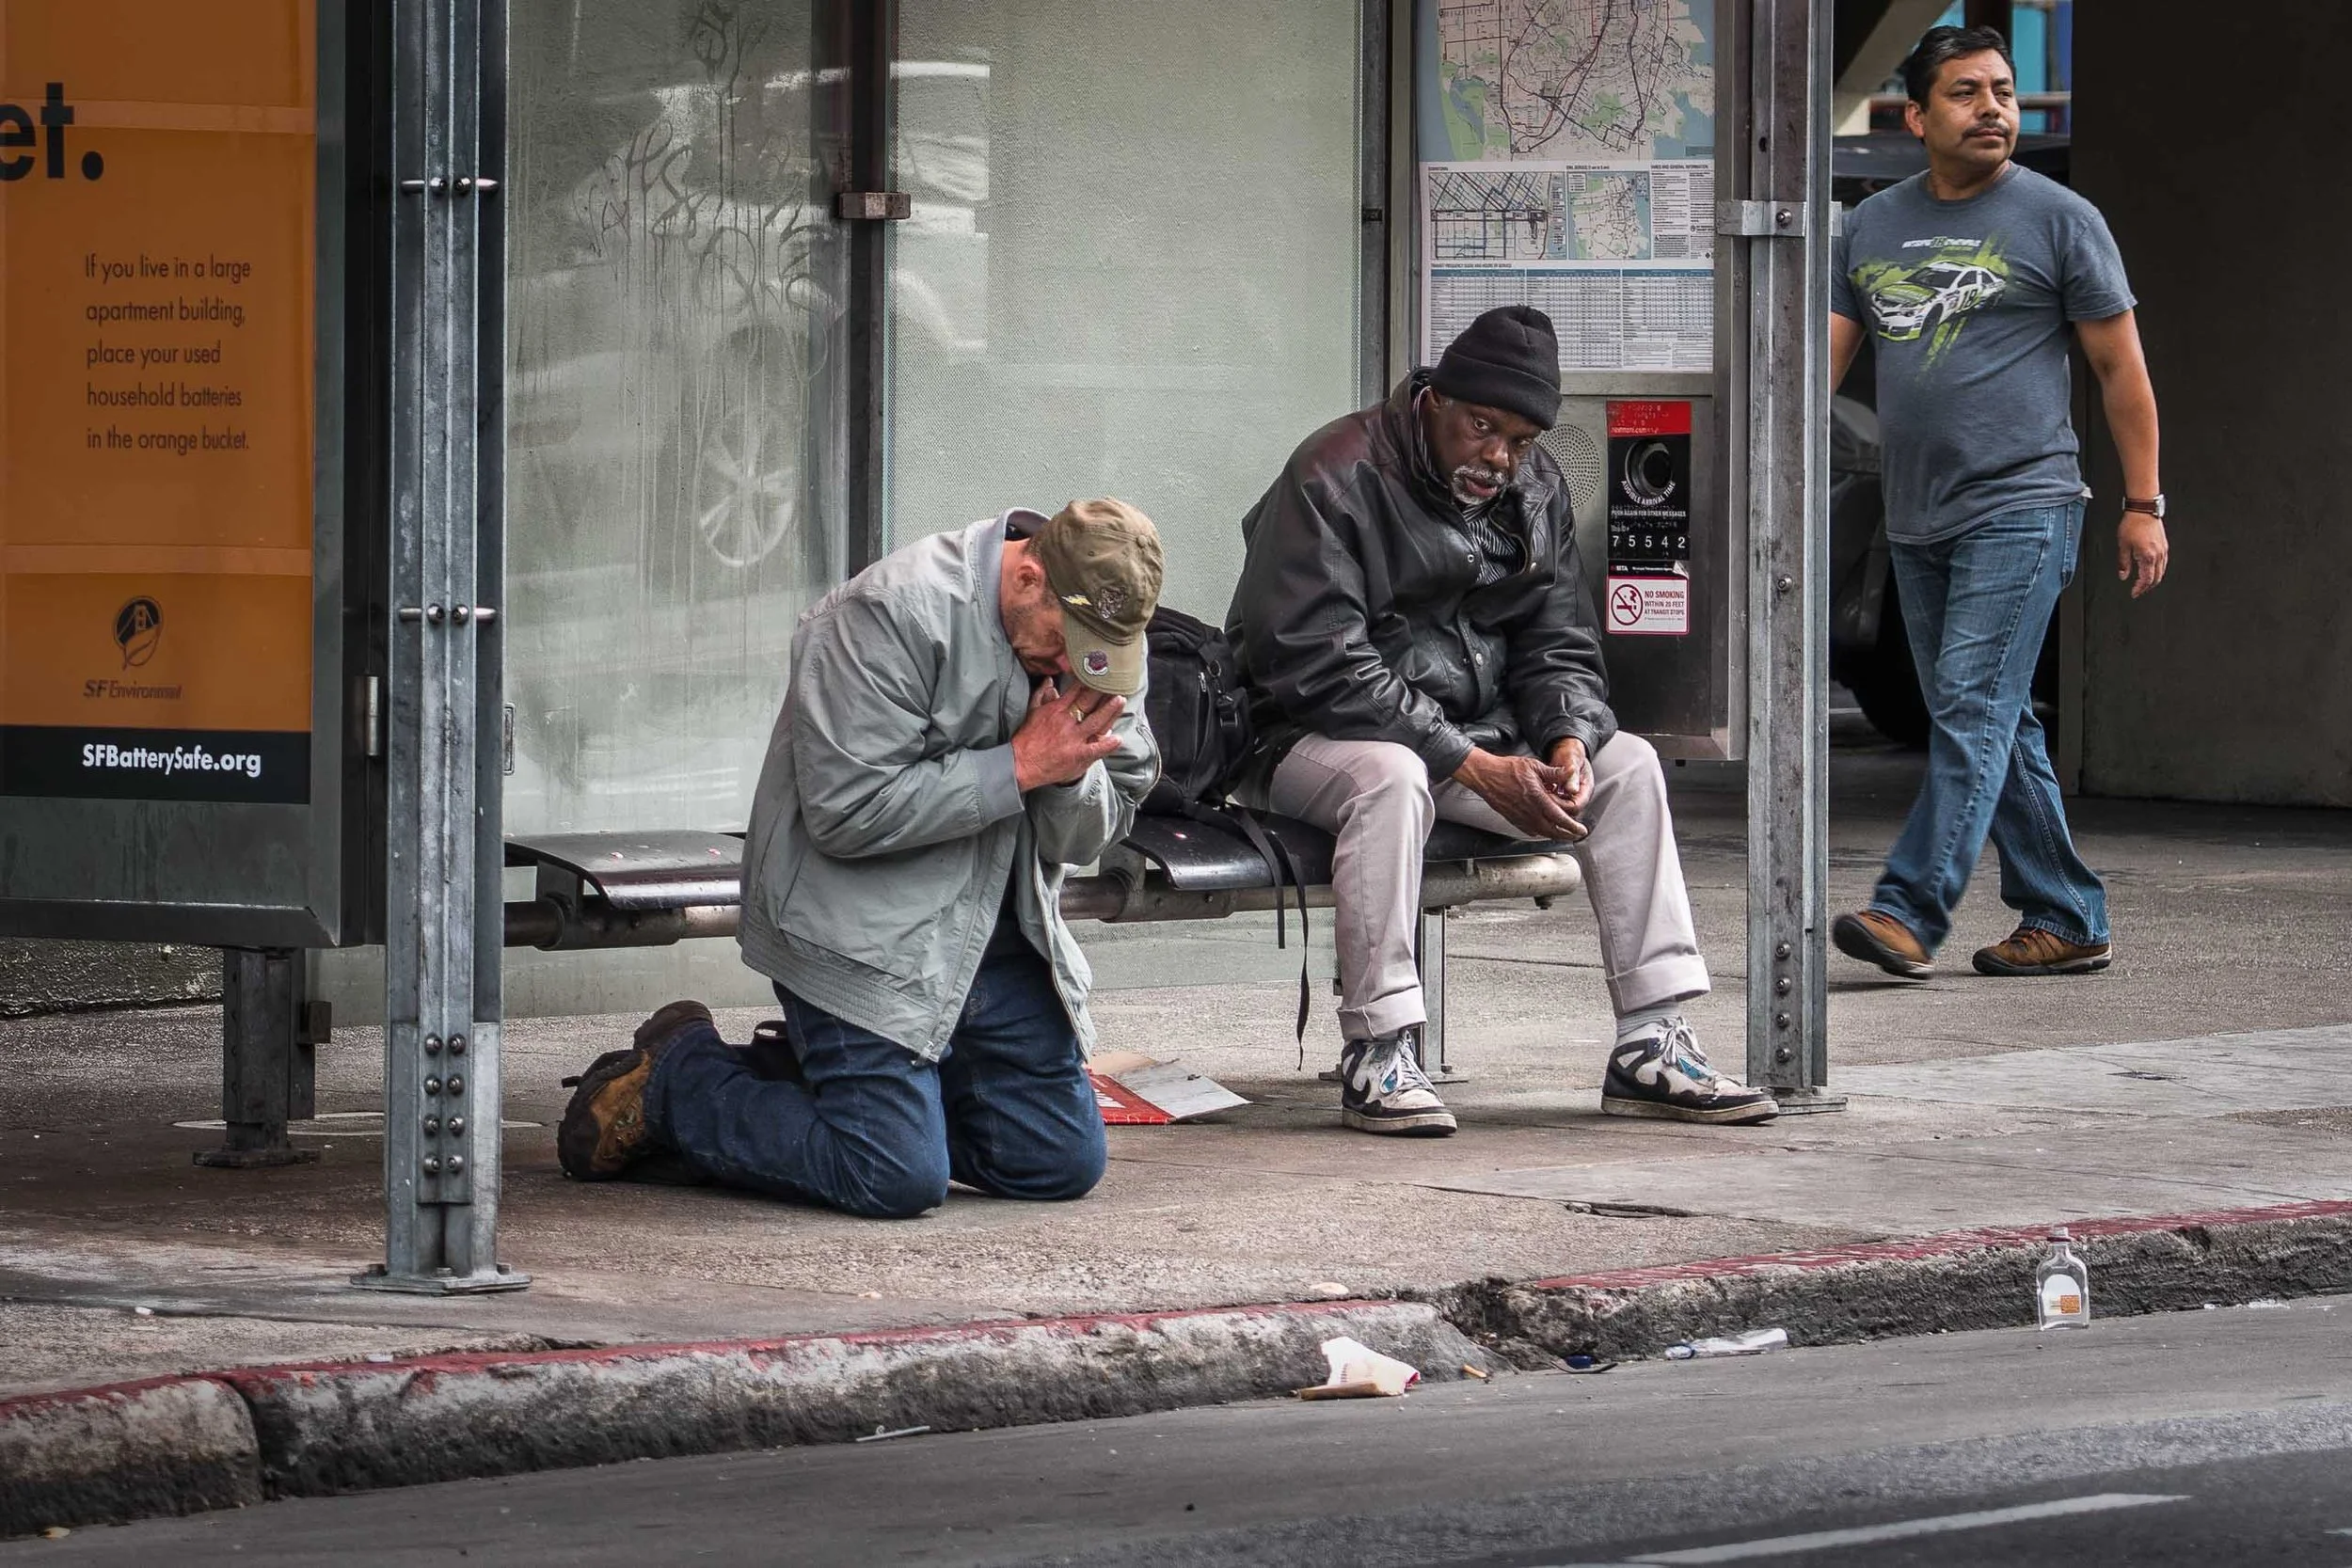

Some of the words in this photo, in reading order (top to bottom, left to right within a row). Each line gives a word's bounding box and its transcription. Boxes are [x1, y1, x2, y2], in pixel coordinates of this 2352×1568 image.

[86, 253, 97, 277] If
[102, 262, 134, 284] you
[140, 254, 169, 277] live
[175, 257, 188, 277] in
[194, 262, 205, 277] a
[211, 253, 251, 284] large
[87, 301, 174, 327] apartment
[179, 296, 246, 328] building,
[1959, 288, 1979, 310] 18
[87, 339, 135, 370] place
[140, 348, 179, 370] your
[184, 340, 221, 363] used
[87, 382, 175, 406] household
[181, 383, 242, 406] batteries
[87, 428, 102, 449] in
[107, 425, 133, 449] the
[138, 434, 198, 456] orange
[202, 426, 249, 451] bucket.
[1663, 481, 1676, 498] TIME
[1656, 591, 1684, 599] SMOKING
[83, 679, 108, 698] SF
[83, 744, 262, 778] SFBatterySafe.org
